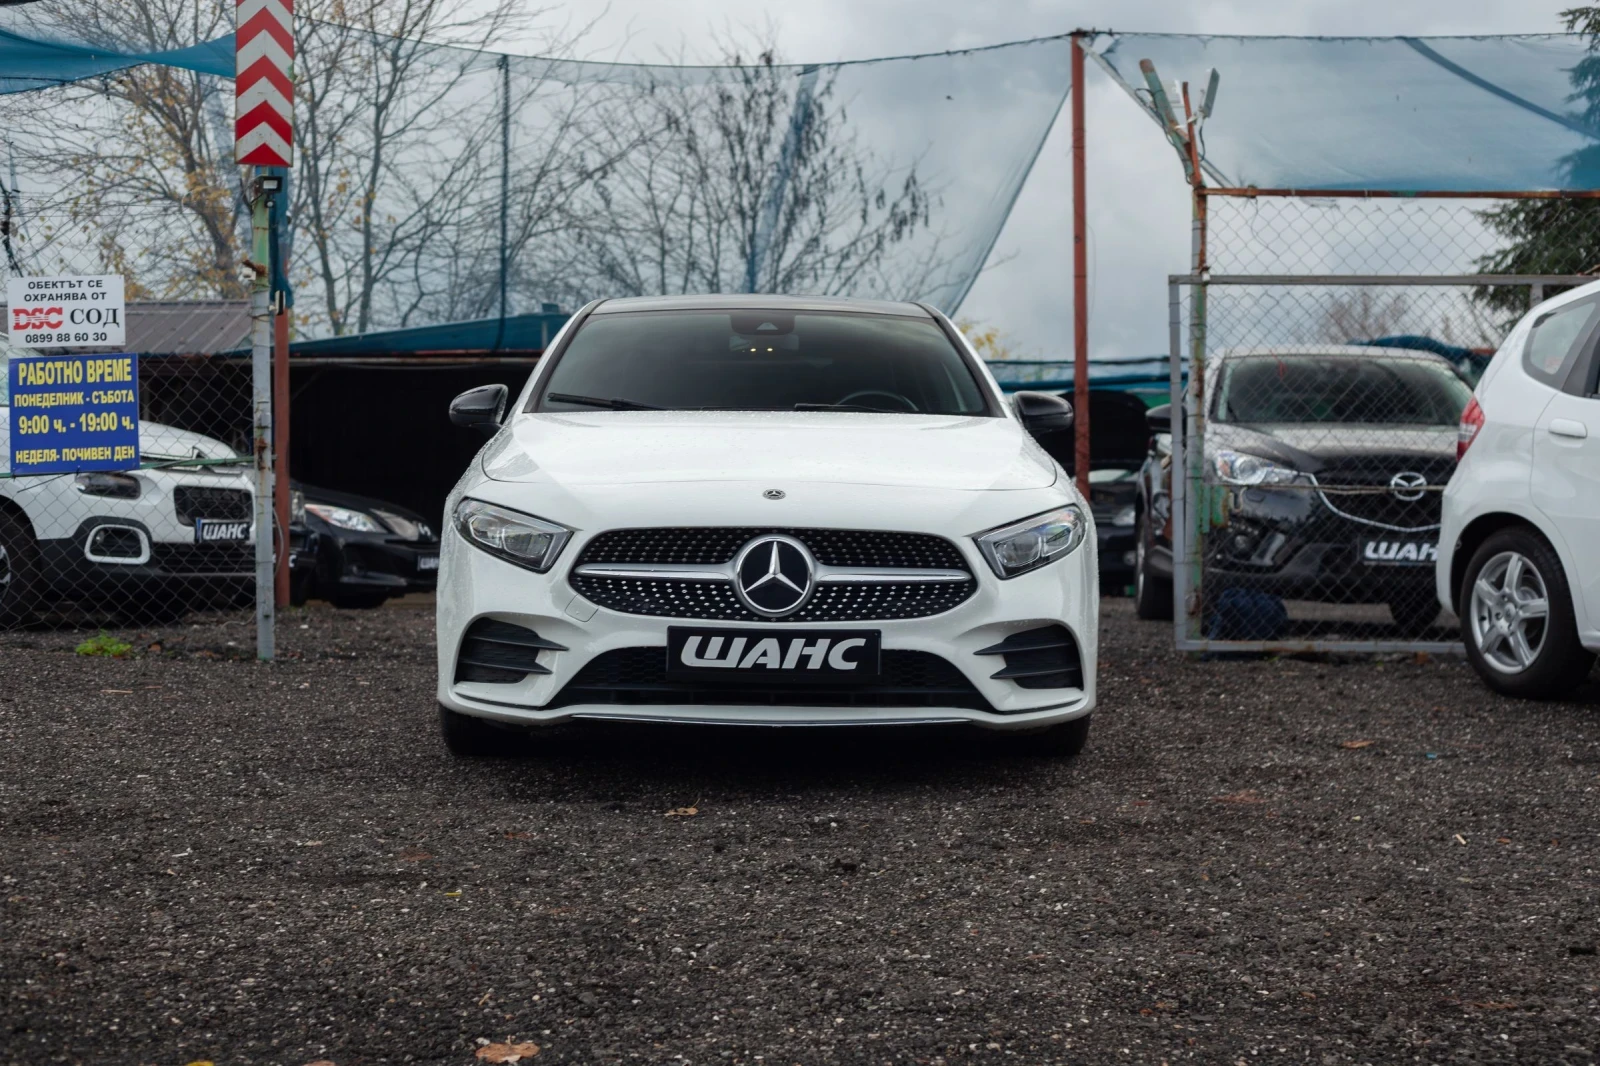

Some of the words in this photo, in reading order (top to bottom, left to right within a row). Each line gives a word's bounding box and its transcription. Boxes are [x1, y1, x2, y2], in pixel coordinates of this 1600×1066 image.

[28, 280, 84, 290] ОБЕКТЪТ
[87, 279, 103, 288] СЕ
[24, 292, 88, 302] ОХРАНЯВА
[91, 292, 107, 300] ОТ
[12, 307, 63, 330] DSC
[69, 308, 120, 328] СОД
[25, 334, 53, 343] 0899
[56, 333, 71, 342] 88
[74, 333, 89, 341] 60
[92, 332, 107, 341] 30
[18, 361, 83, 386] РАБОТНО
[86, 358, 132, 383] ВРЕМЕ
[14, 392, 84, 408] ПОНЕДЕЛНИК
[92, 389, 134, 404] СЪБОТА
[19, 415, 49, 434] 9:00
[53, 419, 66, 433] ч.
[79, 412, 118, 432] 19:00
[121, 416, 134, 430] ч.
[62, 447, 111, 461] ПОЧИВЕН
[113, 445, 135, 461] ДЕН
[202, 523, 247, 540] ШАНС
[1365, 541, 1439, 560] ШАН
[680, 635, 867, 671] ШАНС
